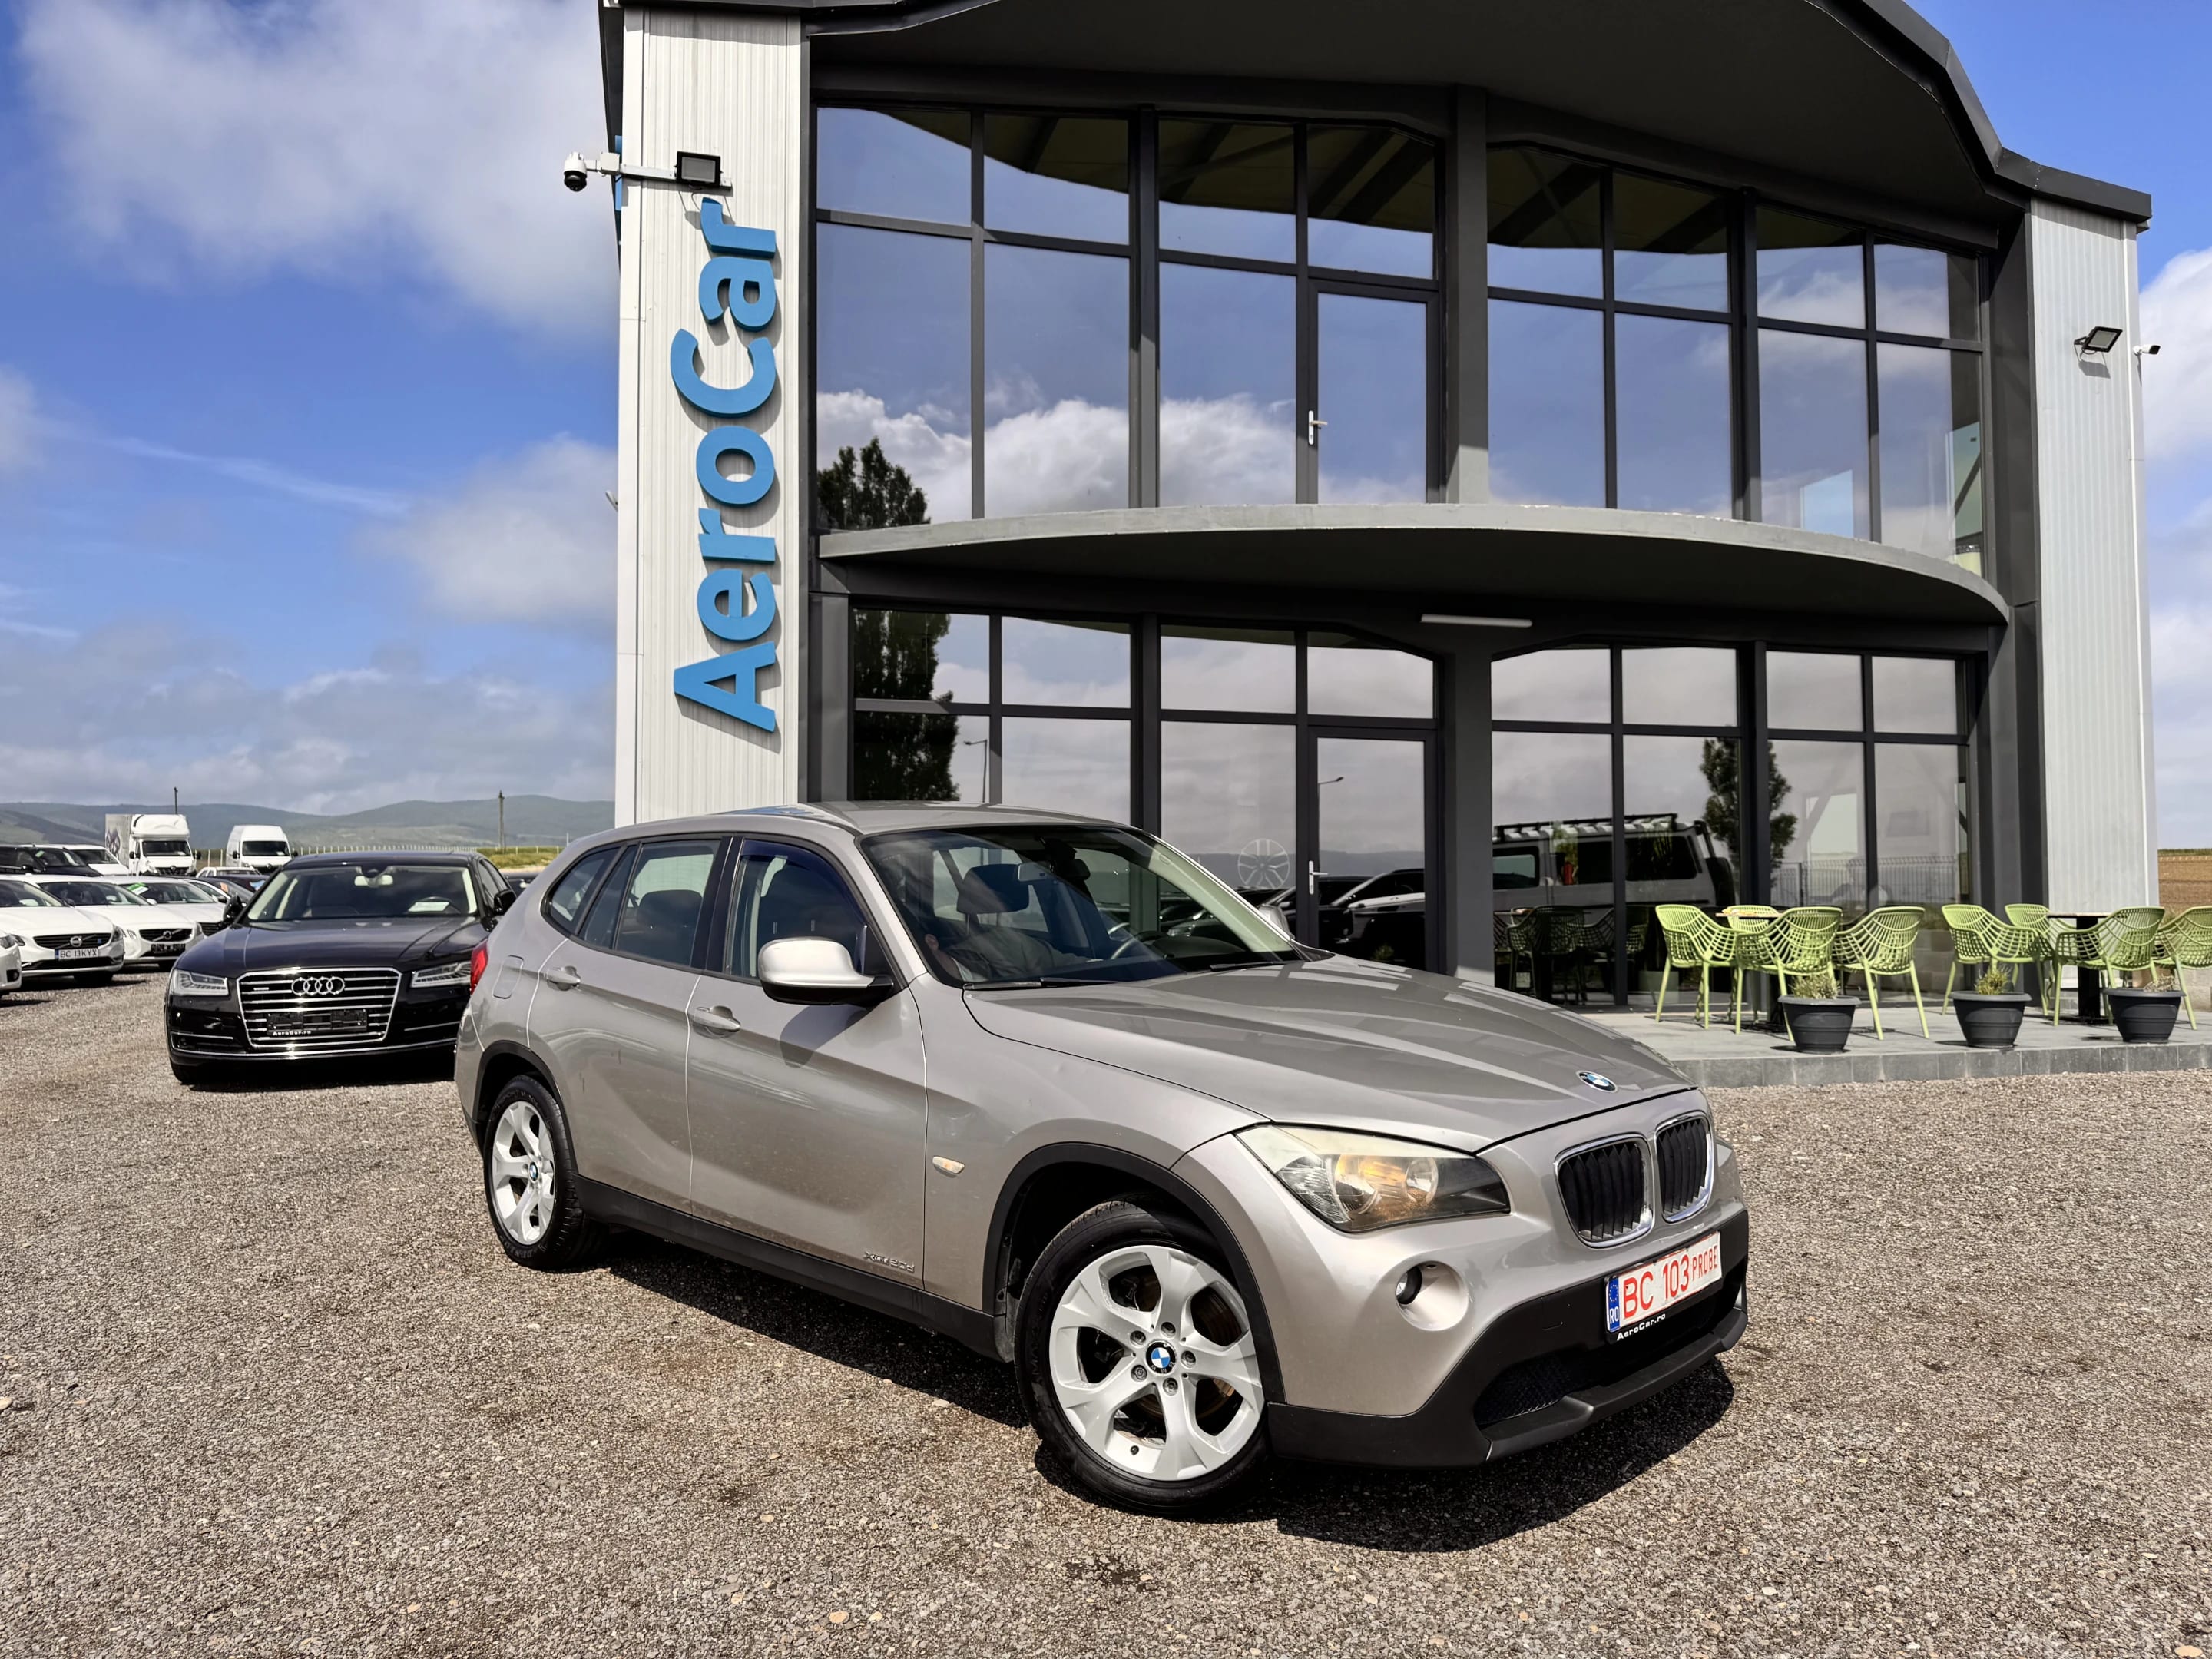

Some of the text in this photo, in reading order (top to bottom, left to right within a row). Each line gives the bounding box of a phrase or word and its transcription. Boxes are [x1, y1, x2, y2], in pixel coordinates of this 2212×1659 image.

[670, 197, 777, 733] AeroCar
[1623, 1245, 1718, 1319] BC 103 PROBE
[1609, 1306, 1619, 1324] RO
[1617, 1313, 1666, 1341] AeroCar.ro
